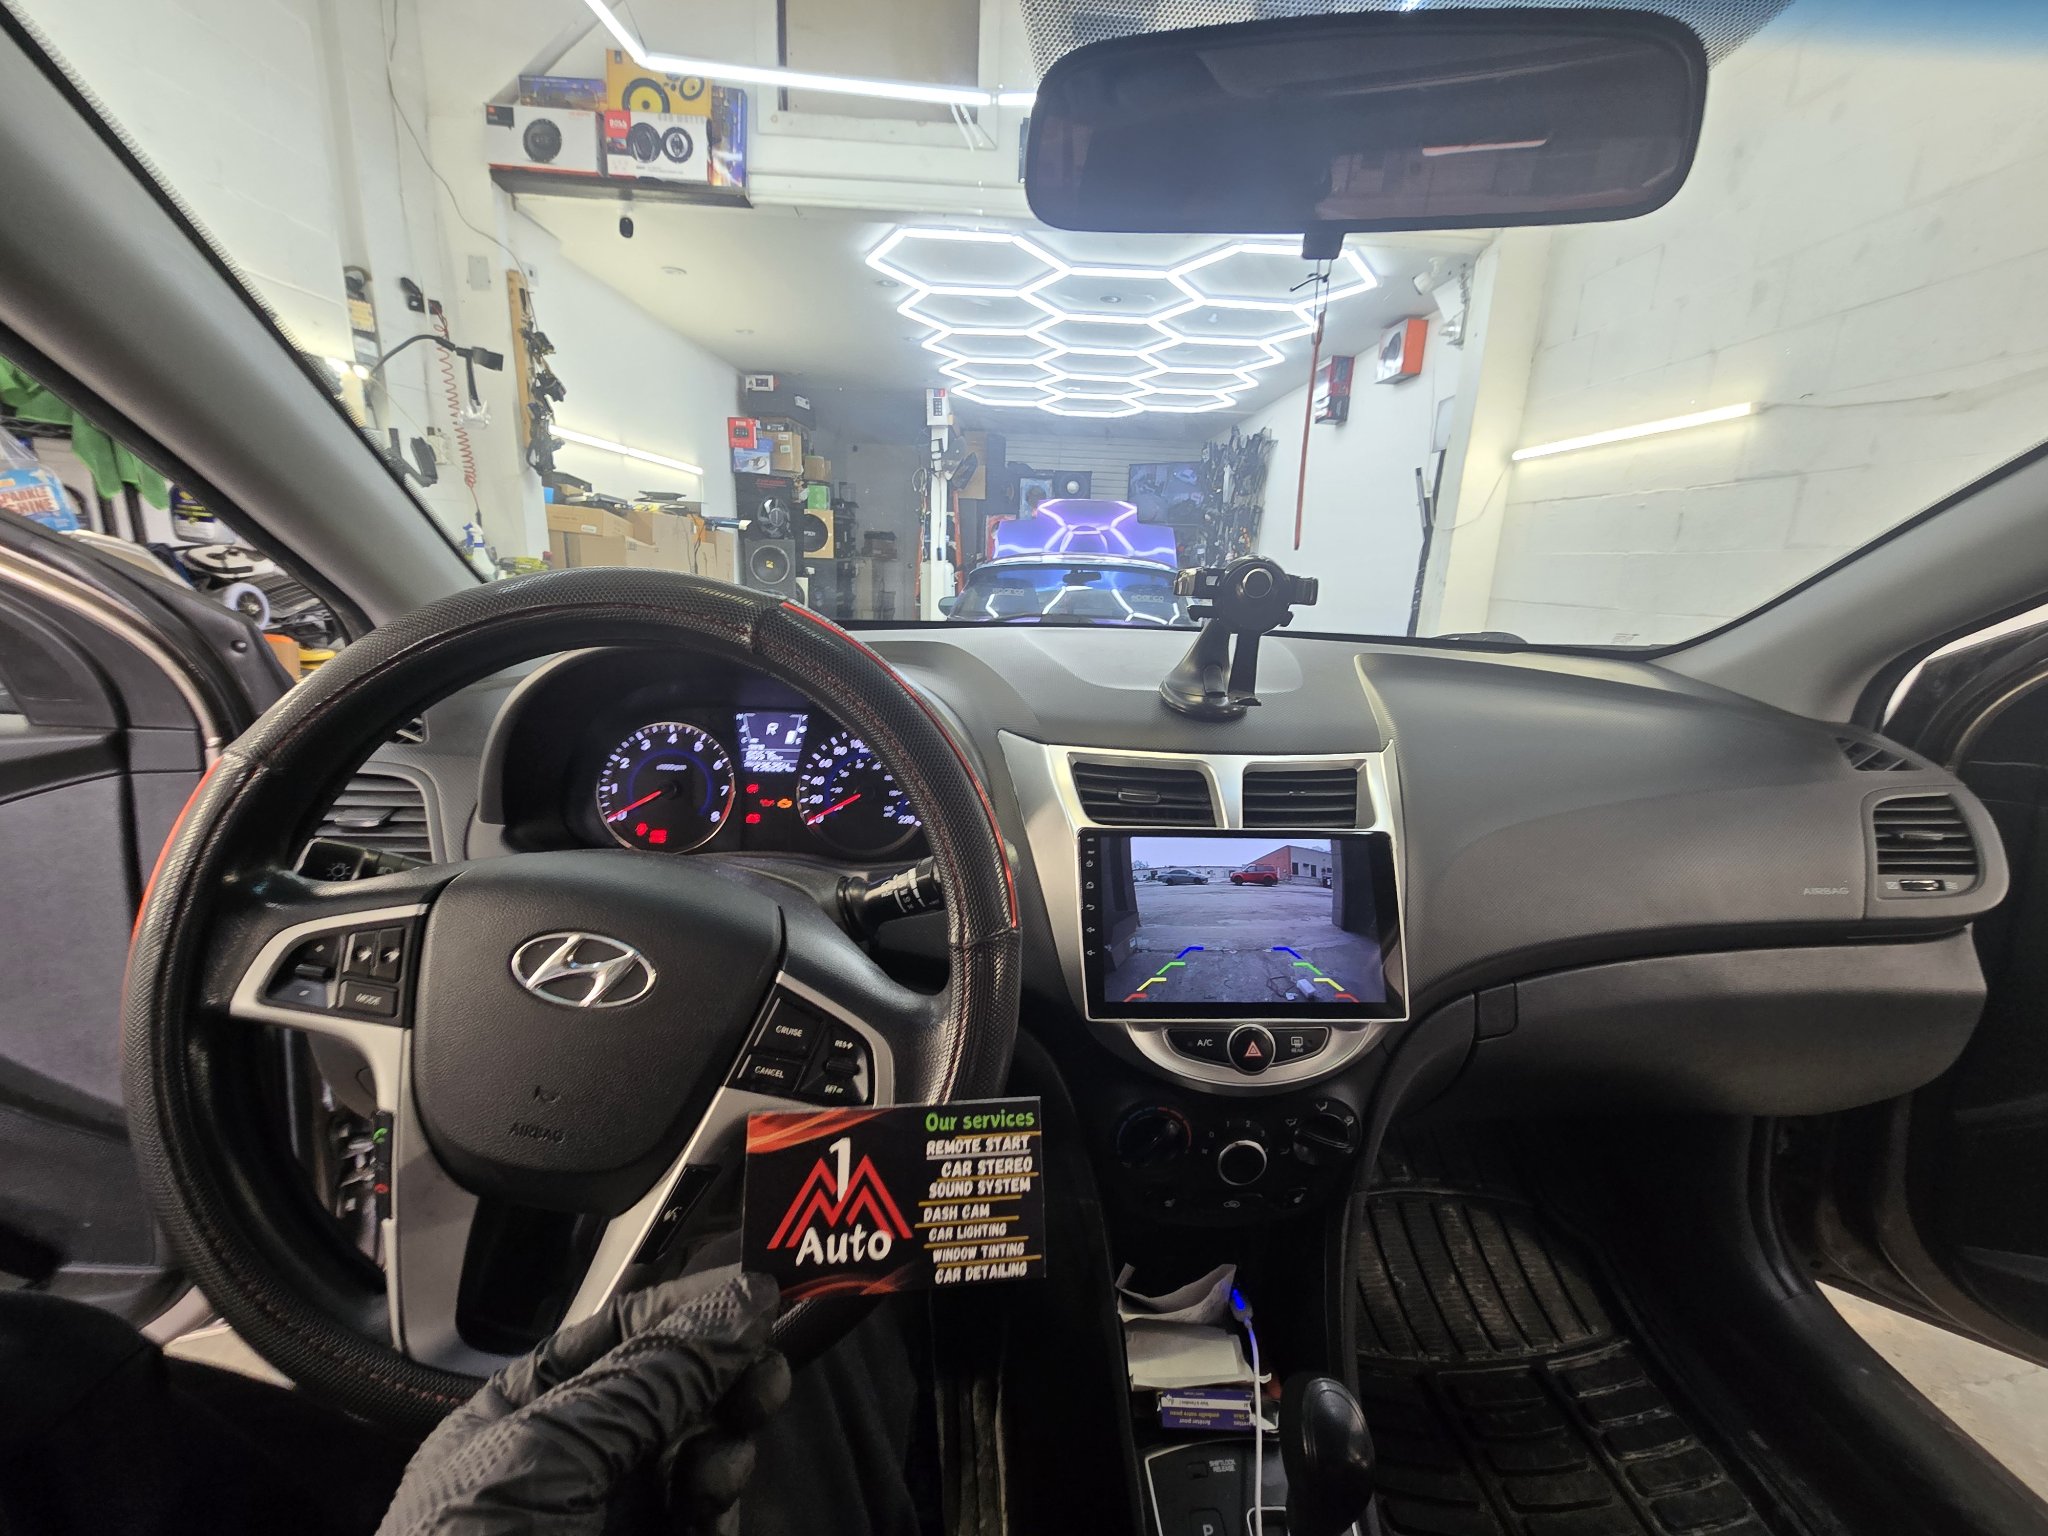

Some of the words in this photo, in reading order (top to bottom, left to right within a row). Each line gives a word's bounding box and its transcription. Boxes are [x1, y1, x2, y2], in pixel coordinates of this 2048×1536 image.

[766, 722, 779, 736] R
[667, 733, 678, 744] 4
[641, 739, 651, 751] 3
[834, 746, 848, 755] 80
[620, 757, 630, 769] 2
[713, 759, 723, 770] 6
[819, 758, 833, 768] 60
[811, 775, 825, 785] 40
[611, 783, 618, 795] 1
[720, 785, 729, 797] 7
[810, 794, 824, 804] 20
[710, 811, 720, 822] 8
[898, 815, 916, 824] 220
[1803, 887, 1849, 896] AIRBAG
[355, 993, 382, 1006] MODE
[775, 1025, 803, 1037] CRUISE
[1197, 1039, 1213, 1047] A/C
[754, 1066, 784, 1079] CANCEL
[926, 1112, 958, 1132] Our
[963, 1109, 1035, 1130] services
[1245, 1120, 1251, 1128] 2
[508, 1121, 566, 1143] AIRBAG
[926, 1138, 982, 1156] REMOTE
[985, 1135, 1031, 1152] START
[828, 1137, 851, 1203] 1
[941, 1160, 973, 1178] CAR
[977, 1156, 1033, 1176] STEREO
[928, 1181, 974, 1199] SOUND
[977, 1177, 1031, 1195] SYSTEM
[923, 1205, 958, 1223] DASH
[961, 1203, 990, 1219] CAM
[928, 1227, 953, 1242] CAR
[956, 1222, 1007, 1240] LIGHTING
[795, 1223, 892, 1267] Auto
[932, 1246, 977, 1264] WINDOW
[981, 1242, 1025, 1259] TINTING
[934, 1267, 961, 1285] CAR
[965, 1261, 1027, 1282] DETAILING
[1203, 1524, 1214, 1536] P
